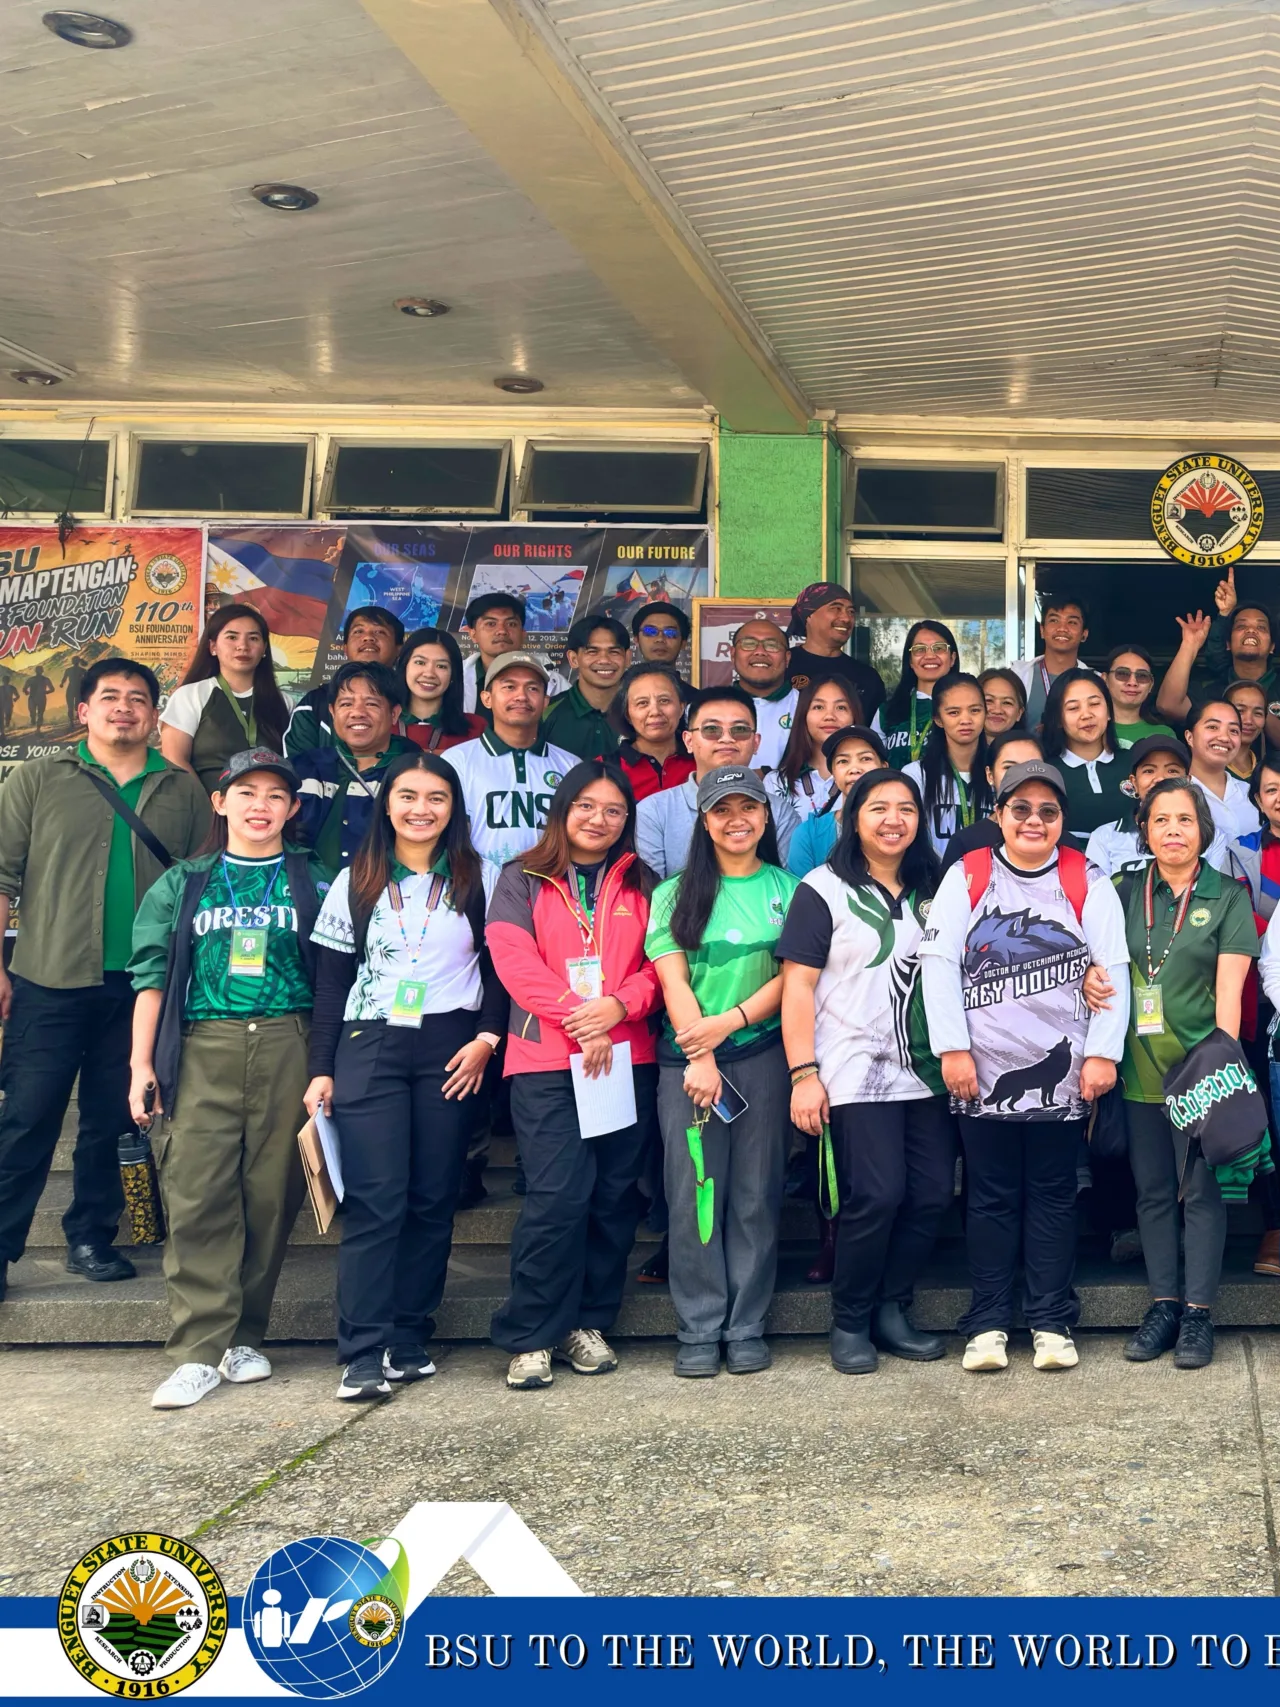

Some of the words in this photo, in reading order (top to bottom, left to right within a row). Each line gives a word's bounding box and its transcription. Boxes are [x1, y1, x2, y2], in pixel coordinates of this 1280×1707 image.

[1152, 483, 1179, 553] BENGUET
[1166, 456, 1211, 482] STATE
[1217, 458, 1263, 554] UNIVERSITY
[373, 543, 399, 556] OUR
[403, 543, 436, 557] SEAS
[493, 544, 521, 558] OUR
[524, 544, 572, 559] RIGHTS
[617, 545, 644, 559] OUR
[647, 546, 696, 560] FUTURE
[1188, 555, 1225, 566] 1916
[7, 584, 128, 628] FOUNDATION
[49, 607, 124, 651] RUN
[129, 624, 144, 633] BSU
[146, 624, 194, 634] FOUNDATION
[135, 635, 188, 644] ANNIVERSARY
[1026, 764, 1046, 773] alo
[485, 790, 555, 830] CNS
[192, 904, 298, 936] OREST
[983, 966, 1009, 979] DOCTOR
[1011, 963, 1021, 972] OF
[1022, 952, 1065, 970] VETERINARY
[1014, 956, 1089, 999] WOLVES
